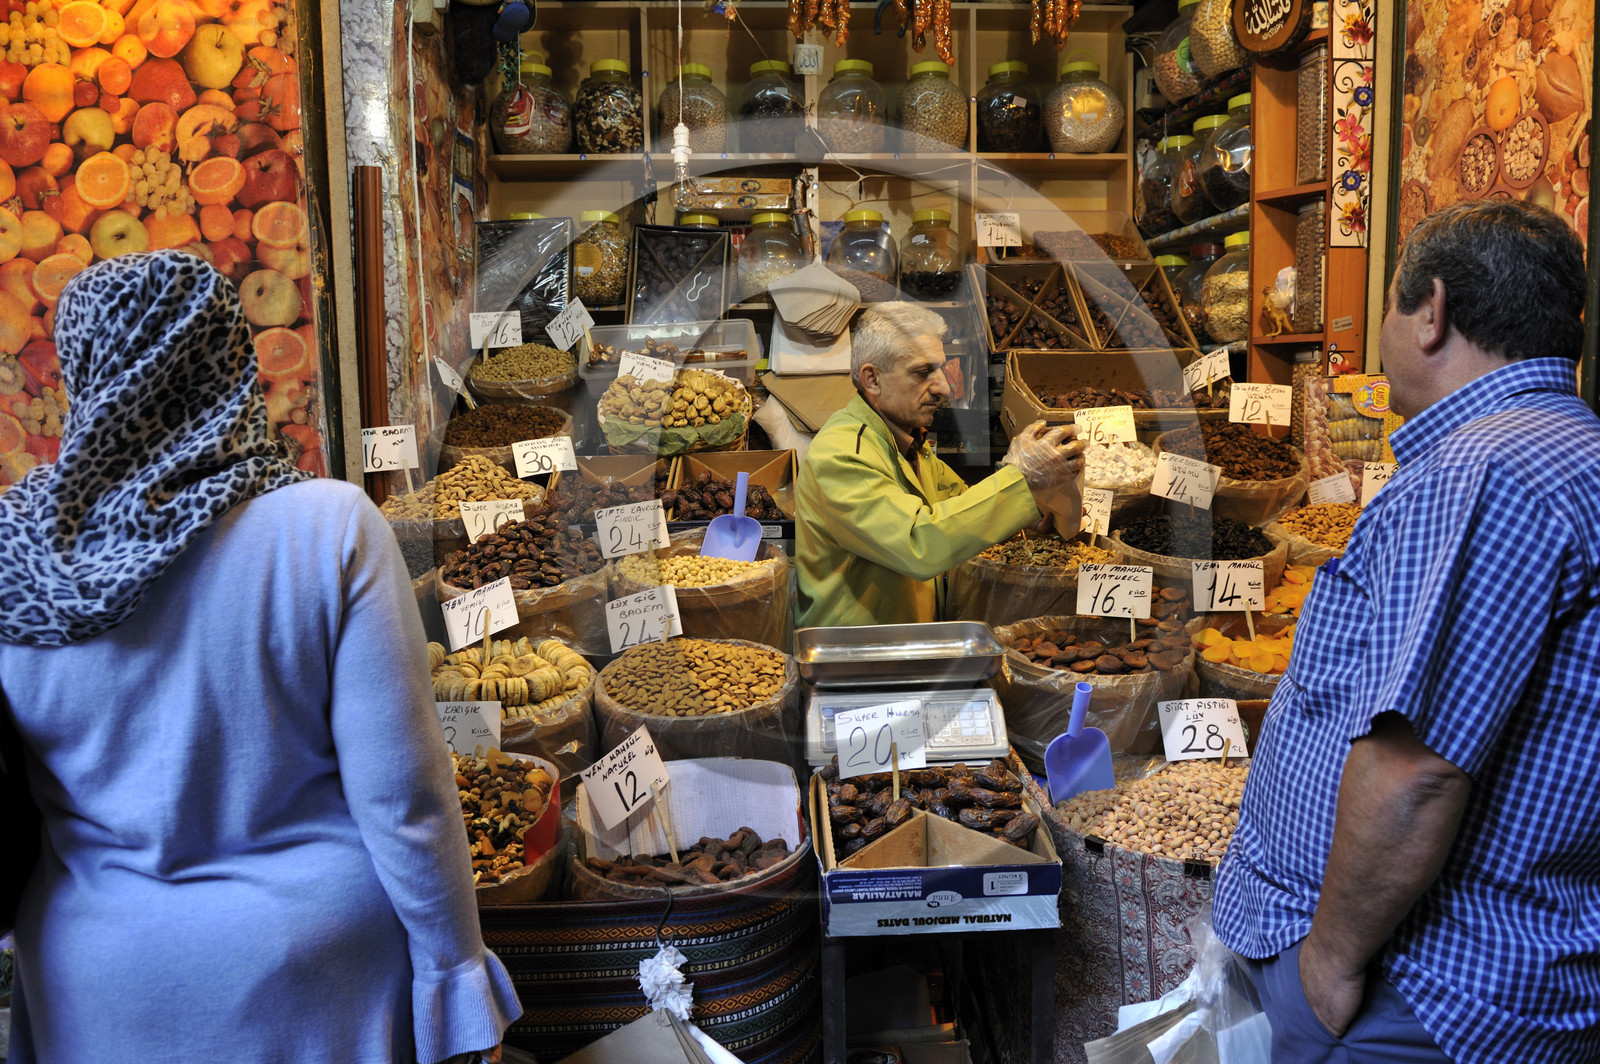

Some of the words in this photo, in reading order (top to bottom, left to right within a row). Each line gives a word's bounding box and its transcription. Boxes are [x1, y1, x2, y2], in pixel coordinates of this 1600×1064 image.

[493, 322, 509, 346] 16
[561, 321, 580, 348] 12
[1190, 361, 1218, 392] 24
[1241, 398, 1262, 422] 12
[361, 429, 378, 437] ITIR
[364, 443, 383, 469] 16
[522, 450, 553, 474] 30
[1166, 475, 1188, 500] 14
[619, 603, 664, 619] BADEM
[464, 606, 491, 644] 10
[619, 619, 659, 650] 24
[837, 711, 879, 726] SÜPER
[886, 707, 921, 719] HURMA
[846, 723, 894, 768] 20
[1180, 723, 1225, 754] 28
[614, 770, 647, 812] 12
[877, 917, 910, 928] DATES
[914, 915, 962, 926] MEDJOUL
[962, 913, 1012, 925] NATURAL
